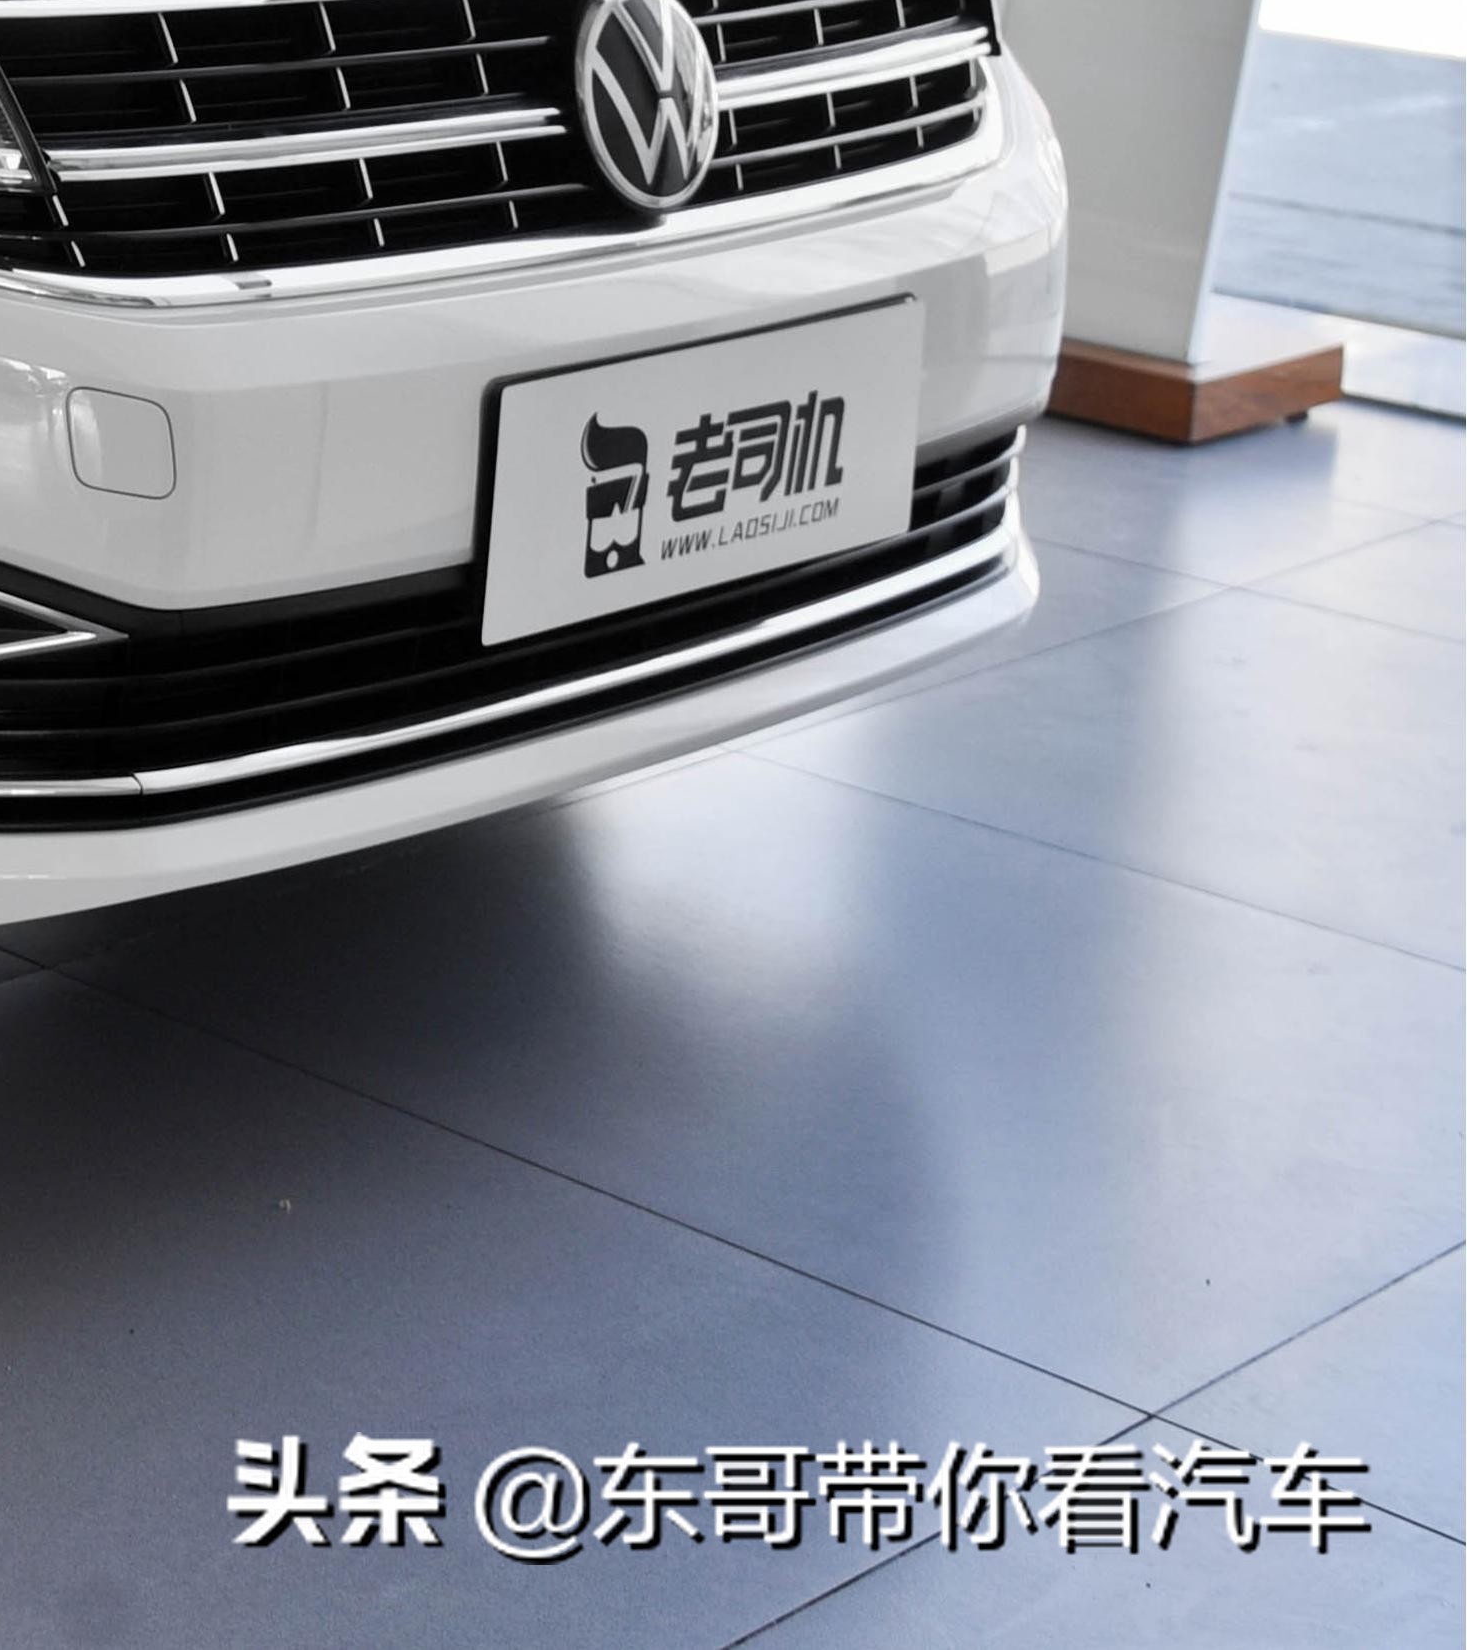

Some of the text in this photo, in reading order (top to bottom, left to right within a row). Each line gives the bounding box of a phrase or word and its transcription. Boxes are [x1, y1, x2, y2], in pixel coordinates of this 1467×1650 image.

[667, 390, 845, 522] 老司机
[660, 498, 839, 561] WWW.LAOSIJI.COM
